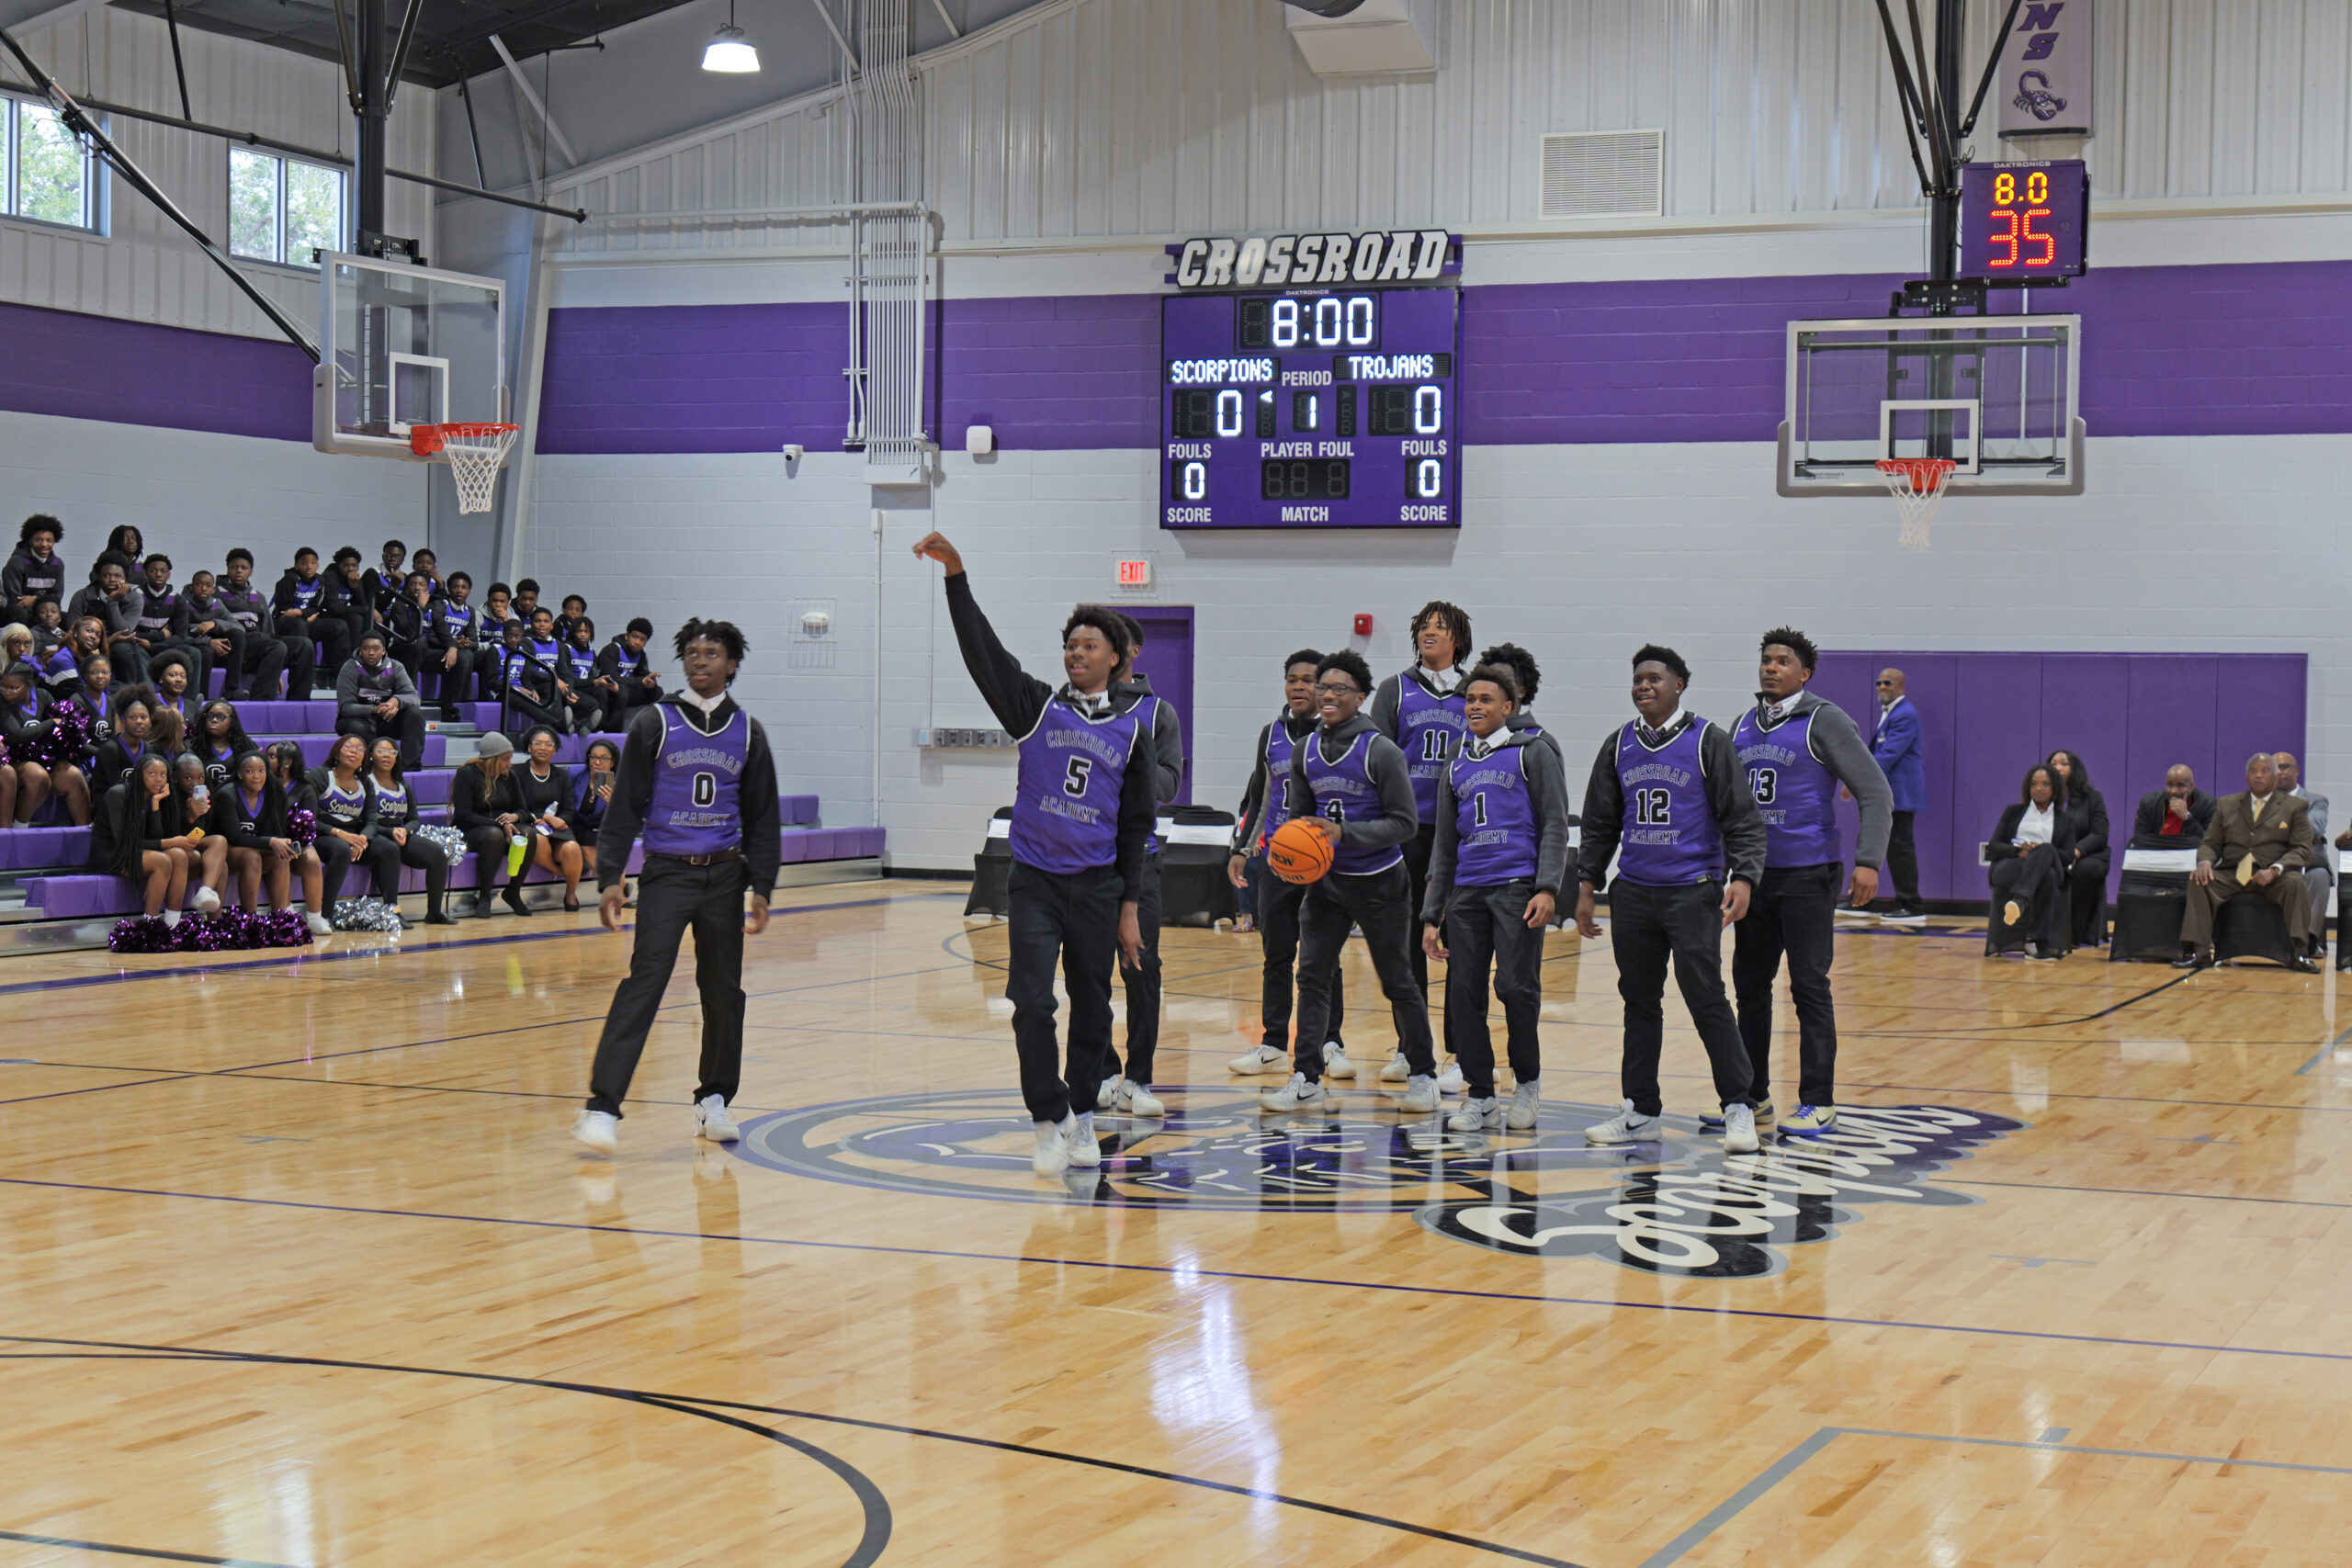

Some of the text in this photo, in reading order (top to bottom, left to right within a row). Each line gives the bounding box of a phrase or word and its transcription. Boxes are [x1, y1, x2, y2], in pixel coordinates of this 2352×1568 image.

[2017, 0, 2065, 61] NS
[1993, 160, 2051, 169] DAKTRONICS
[1995, 171, 2049, 205] 8.0
[1989, 208, 2054, 266] 35
[1177, 230, 1450, 287] CROSSROAD
[1272, 297, 1374, 347] 8:00
[1171, 358, 1273, 383] SCORPIONS
[1282, 370, 1332, 387] PERIOD
[1348, 355, 1434, 379] TROJANS
[1216, 389, 1242, 437] 0
[1308, 395, 1317, 429] 1
[1414, 385, 1442, 434] 0
[1168, 444, 1212, 459] FOULS
[1261, 441, 1355, 457] PLAYER FOUL
[1401, 440, 1447, 456] FOULS
[1184, 461, 1205, 500] 0
[1419, 458, 1441, 497] 0
[1167, 507, 1212, 523] SCORE
[1282, 506, 1329, 522] MATCH
[1400, 505, 1447, 521] SCORE
[1120, 561, 1146, 583] EXIT
[1406, 709, 1468, 732] CROSSROAD
[1046, 728, 1123, 770] CROSSROAD
[1422, 729, 1449, 761] 11
[1738, 743, 1796, 767] ROSSROAD
[666, 748, 742, 775] CROSSROAD
[1063, 754, 1092, 799] 5
[1623, 763, 1690, 787] CROSSROAD
[692, 772, 717, 807] 0
[1457, 769, 1515, 800] CROSSROAD
[669, 810, 731, 827] ACADEMY
[1039, 795, 1101, 825] ACADEMY
[1325, 798, 1345, 824] 4
[1474, 792, 1487, 827] 1
[1635, 788, 1671, 825] 12
